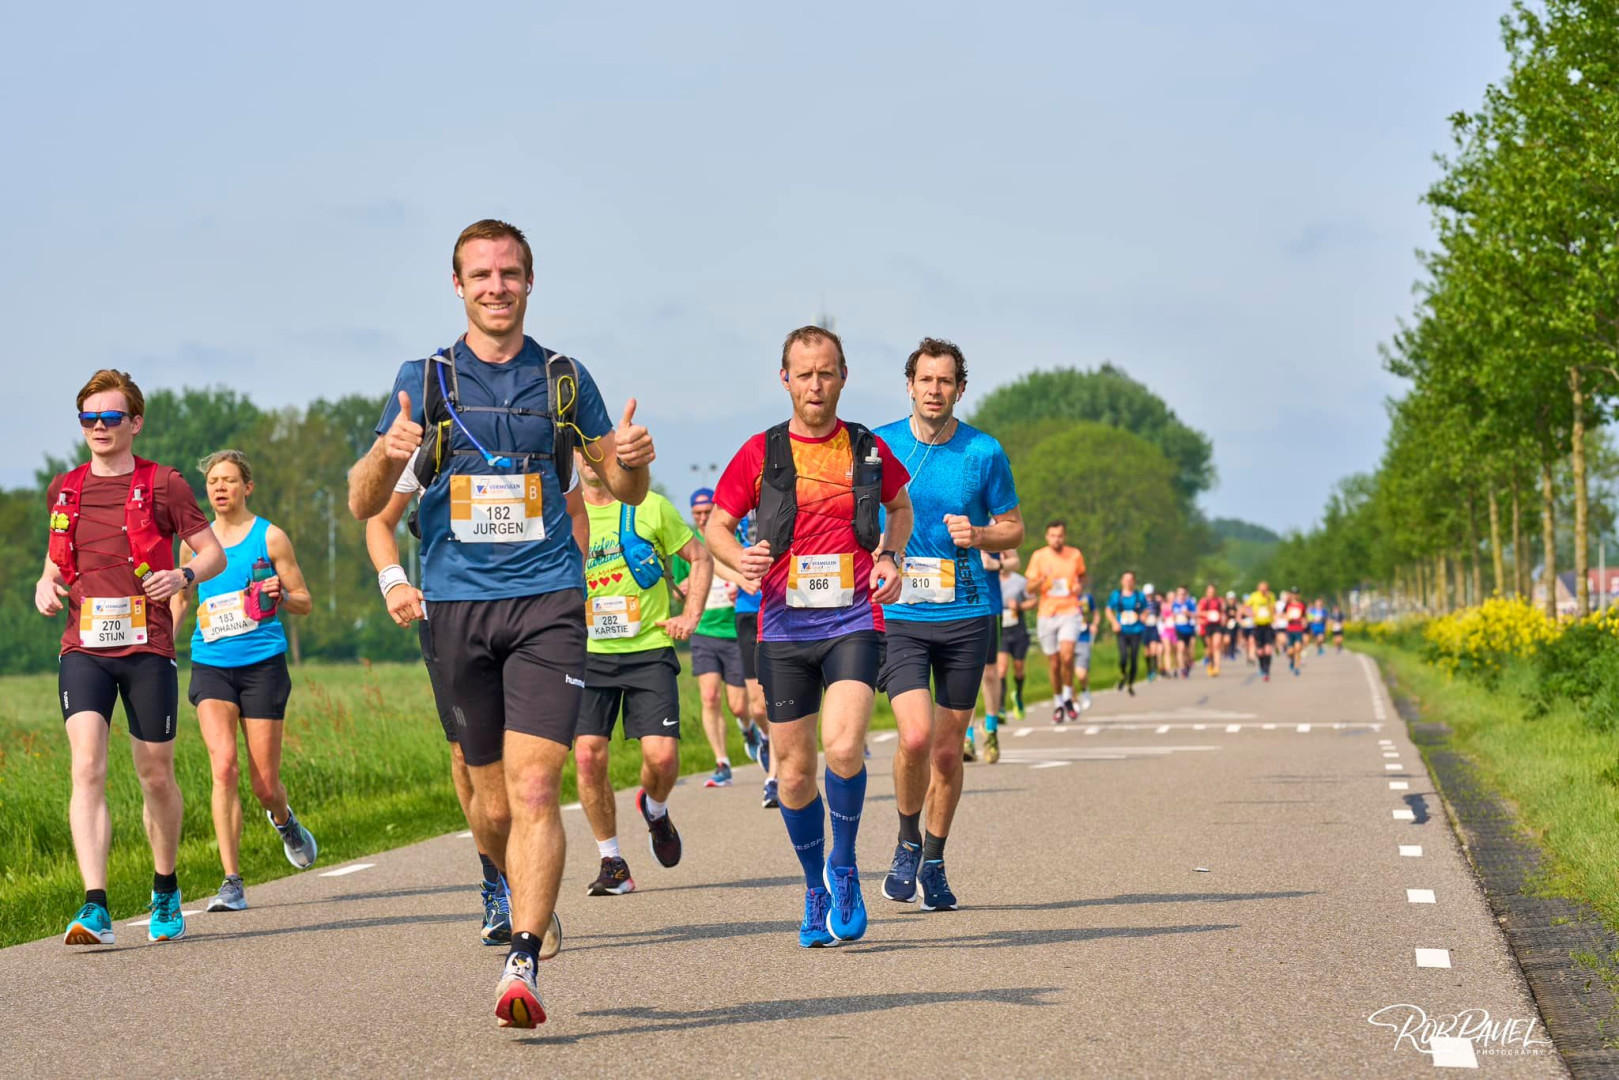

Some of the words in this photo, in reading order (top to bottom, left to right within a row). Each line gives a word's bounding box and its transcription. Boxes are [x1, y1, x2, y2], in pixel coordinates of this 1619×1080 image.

[529, 485, 537, 500] B
[487, 506, 510, 520] 182
[473, 522, 524, 535] JURGEN
[809, 578, 829, 590] 866
[912, 578, 930, 588] 810
[134, 604, 142, 615] B
[219, 612, 234, 624] 183
[602, 615, 618, 626] 282
[102, 620, 121, 631] 270
[211, 620, 248, 636] JOHANNA
[595, 625, 629, 635] KARSTIE
[99, 631, 125, 642] STIJN
